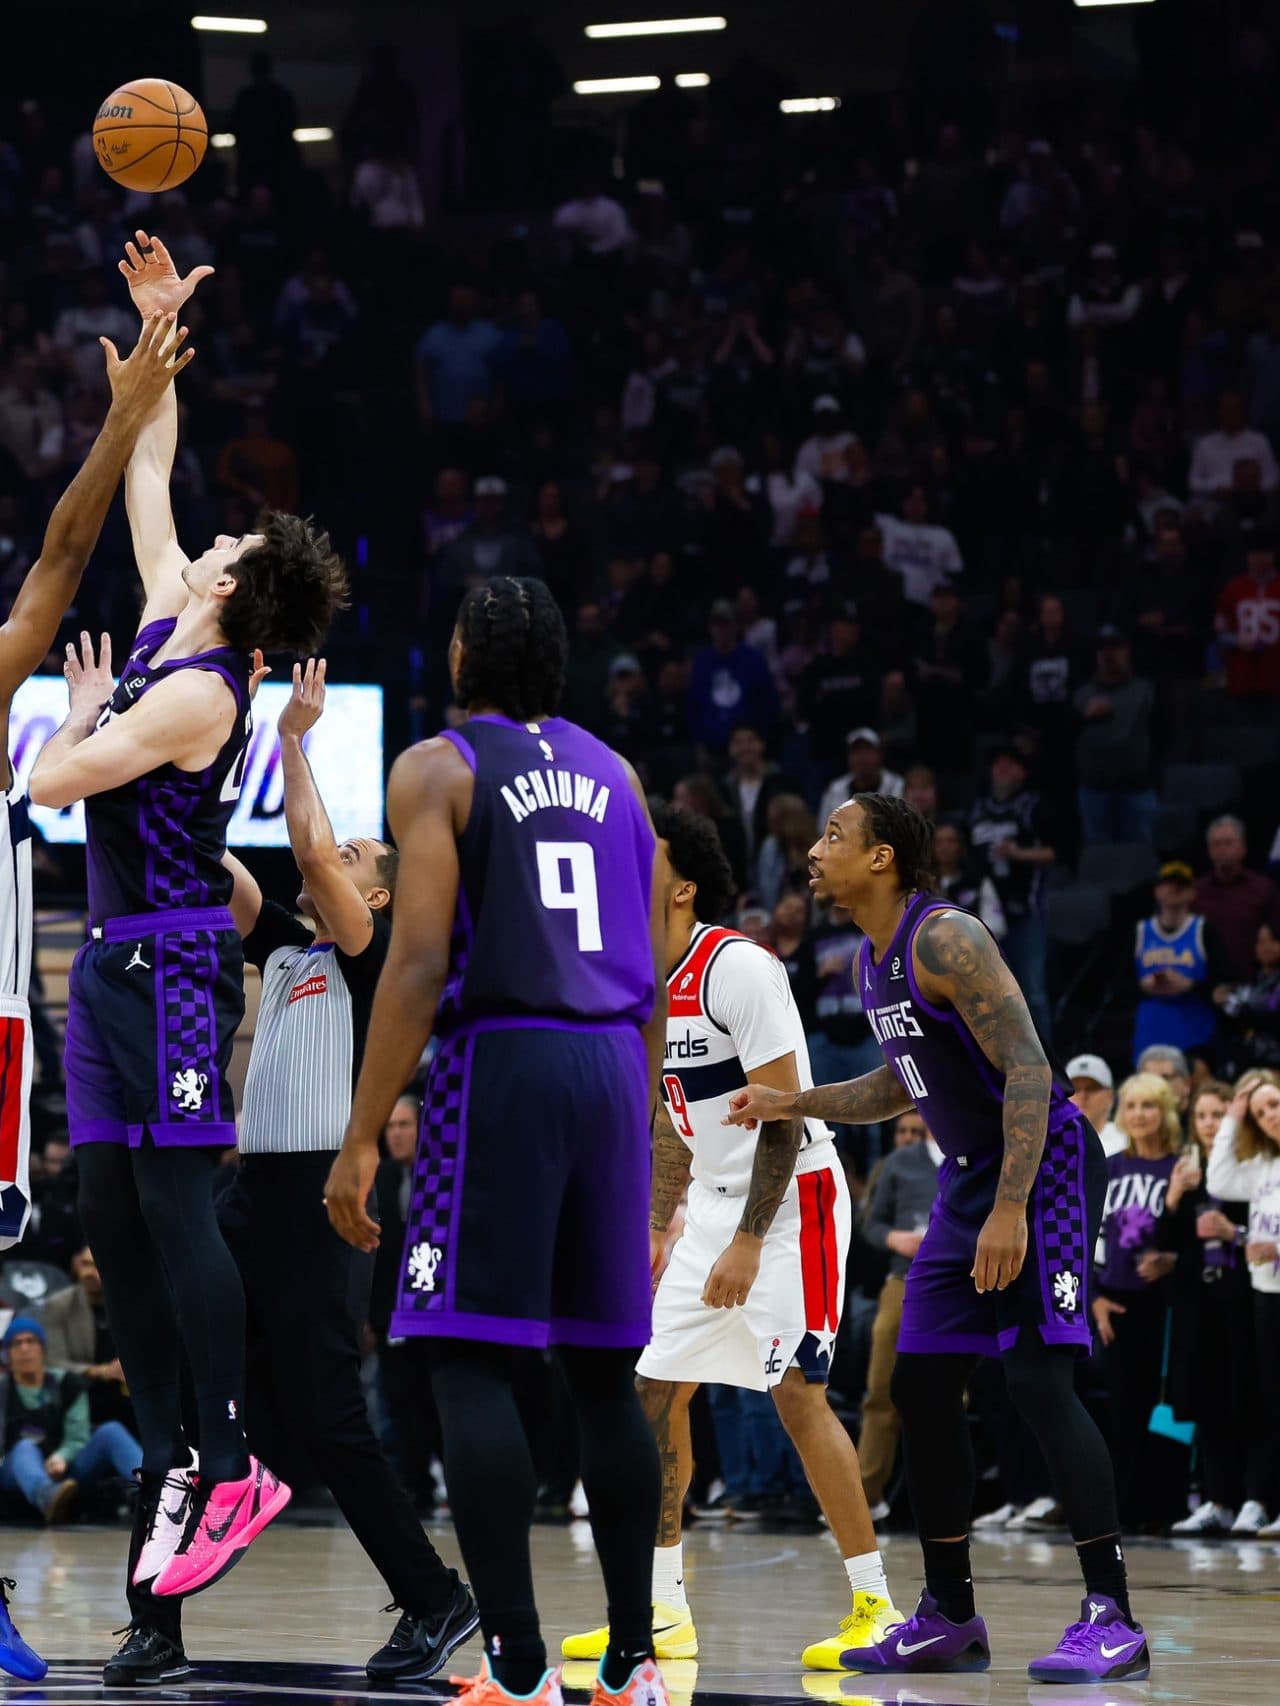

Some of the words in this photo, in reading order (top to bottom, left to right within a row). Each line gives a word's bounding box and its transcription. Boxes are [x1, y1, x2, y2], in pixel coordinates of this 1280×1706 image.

[500, 769, 610, 823] ACHIUWA
[536, 841, 603, 951] 9
[663, 1074, 695, 1138] 9
[895, 1054, 928, 1099] 10
